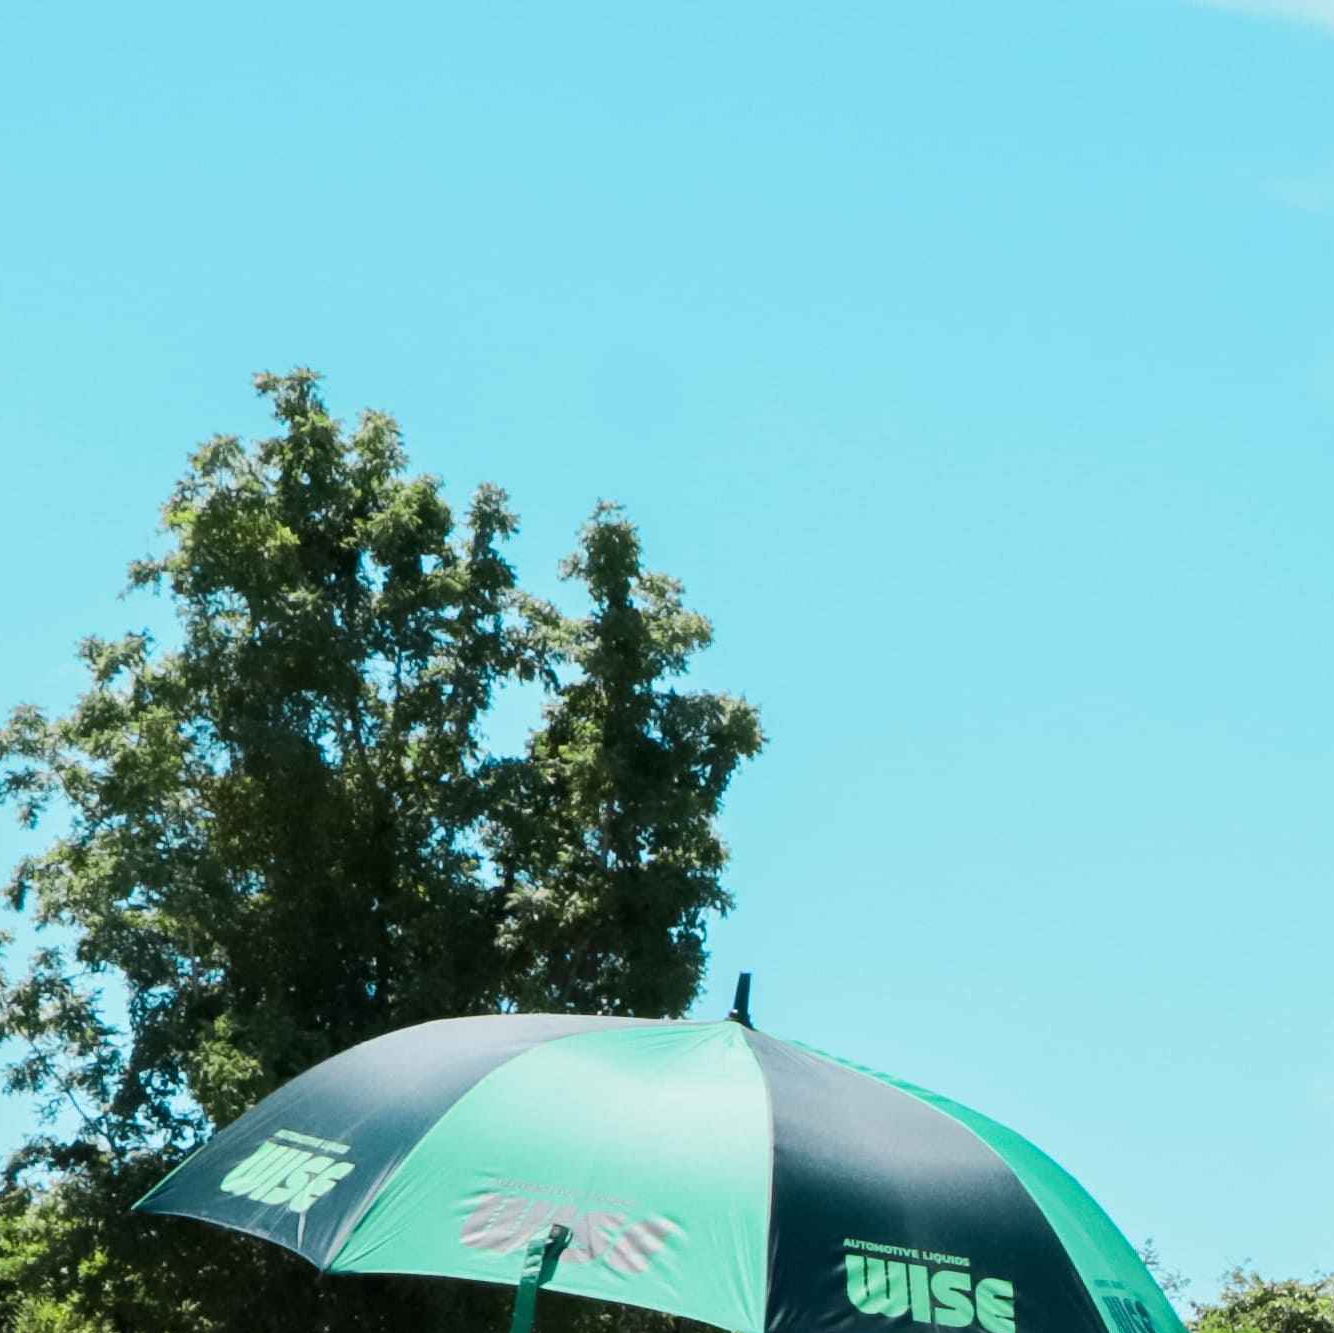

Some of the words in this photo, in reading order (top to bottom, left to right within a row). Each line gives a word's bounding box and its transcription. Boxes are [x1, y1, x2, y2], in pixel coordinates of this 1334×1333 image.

[220, 1141, 356, 1213] WISE
[842, 1237, 919, 1260] AUTOMOTIVE
[921, 1250, 971, 1267] LIQUIDS
